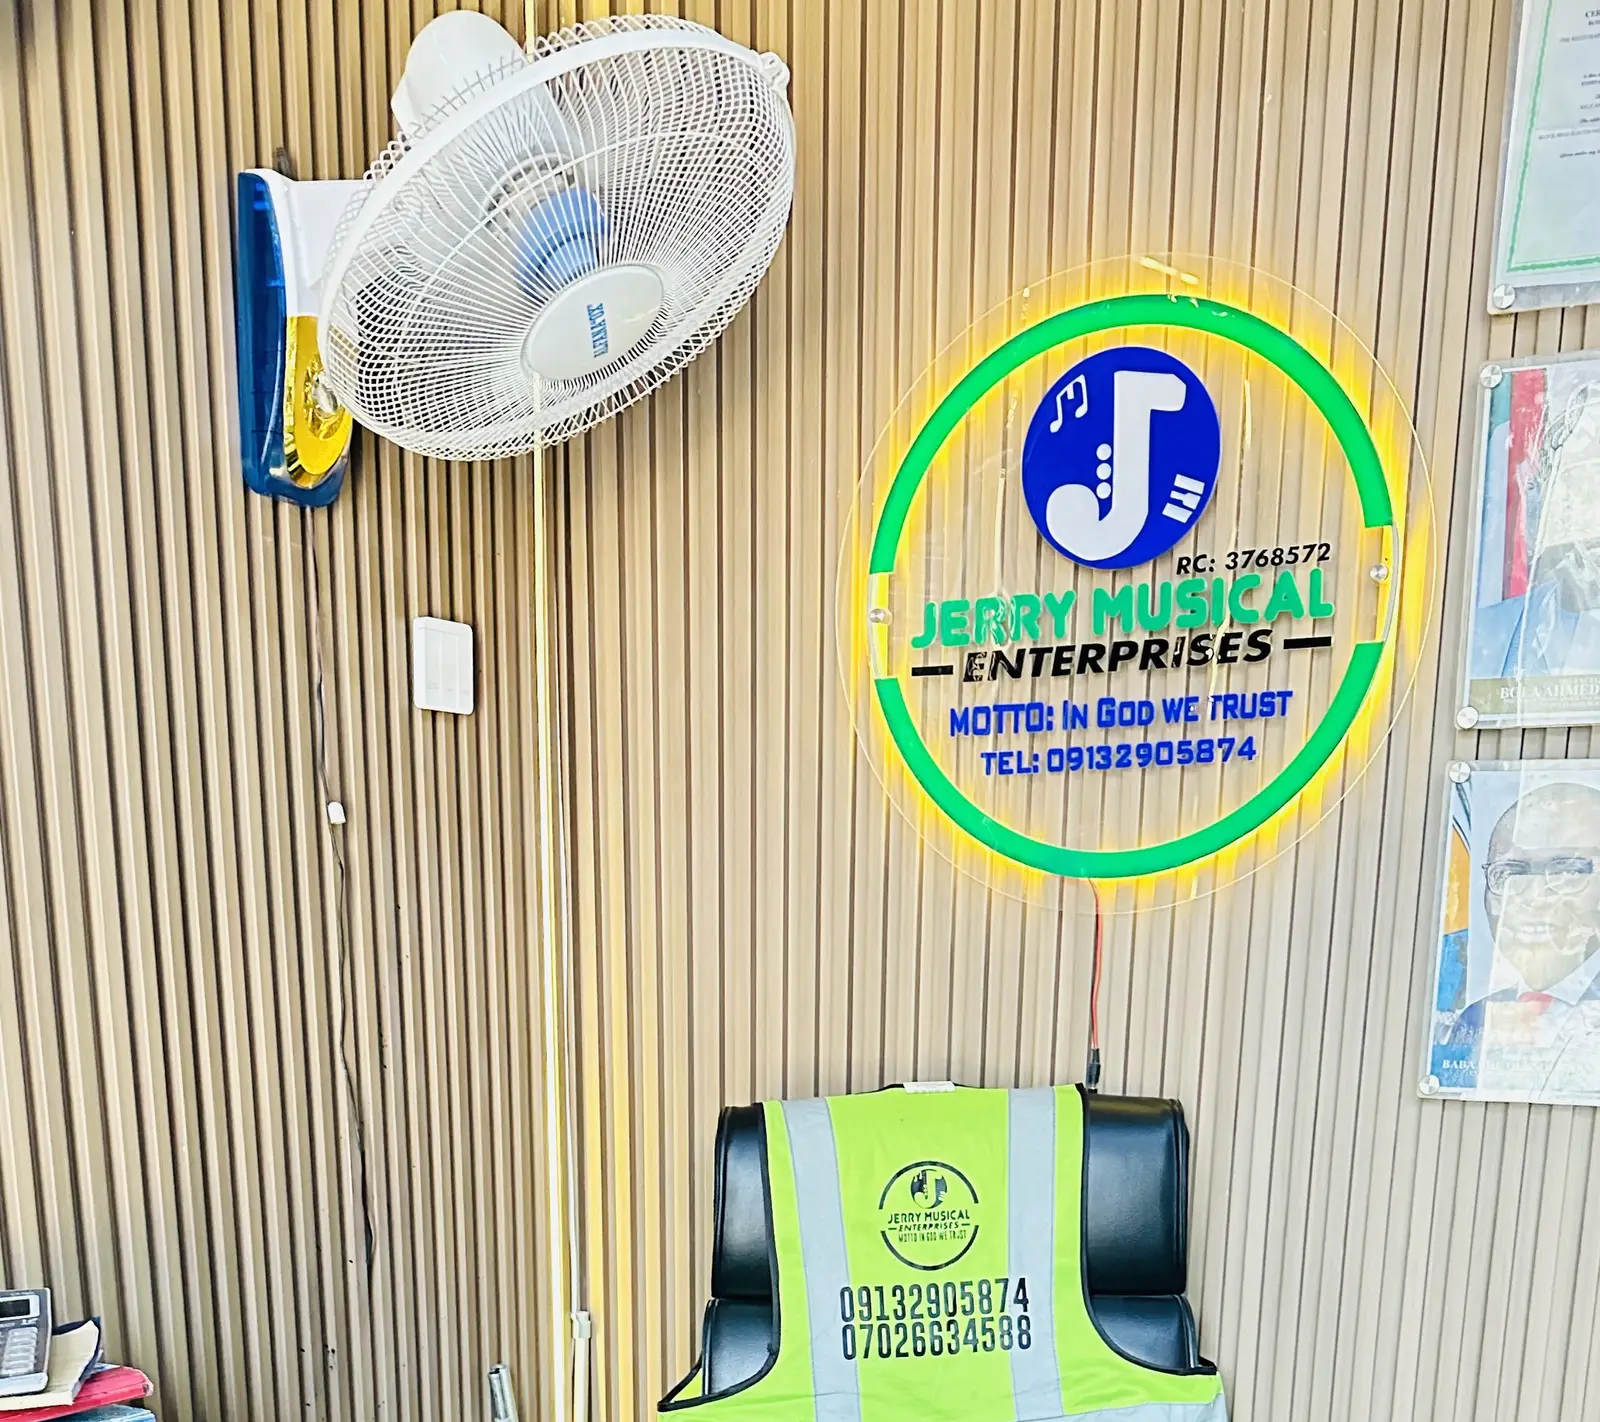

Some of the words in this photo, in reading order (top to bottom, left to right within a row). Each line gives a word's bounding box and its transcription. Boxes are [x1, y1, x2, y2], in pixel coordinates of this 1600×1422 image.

[1176, 553, 1216, 575] RC:
[1225, 543, 1331, 570] 3768572
[911, 590, 1076, 648] JERRY
[1093, 567, 1334, 635] MUSICAL
[963, 629, 1273, 682] ENTERPRISES
[950, 702, 1054, 736] MOTTO:
[981, 751, 1039, 776] TEL:
[1047, 736, 1257, 773] 09132905874
[888, 1212, 921, 1224] JERRY
[925, 1209, 970, 1221] MUSICAL
[899, 1222, 959, 1232] ENTERPRISES
[840, 1277, 1029, 1322] 09132905874
[841, 1315, 1031, 1360] 07026634588
